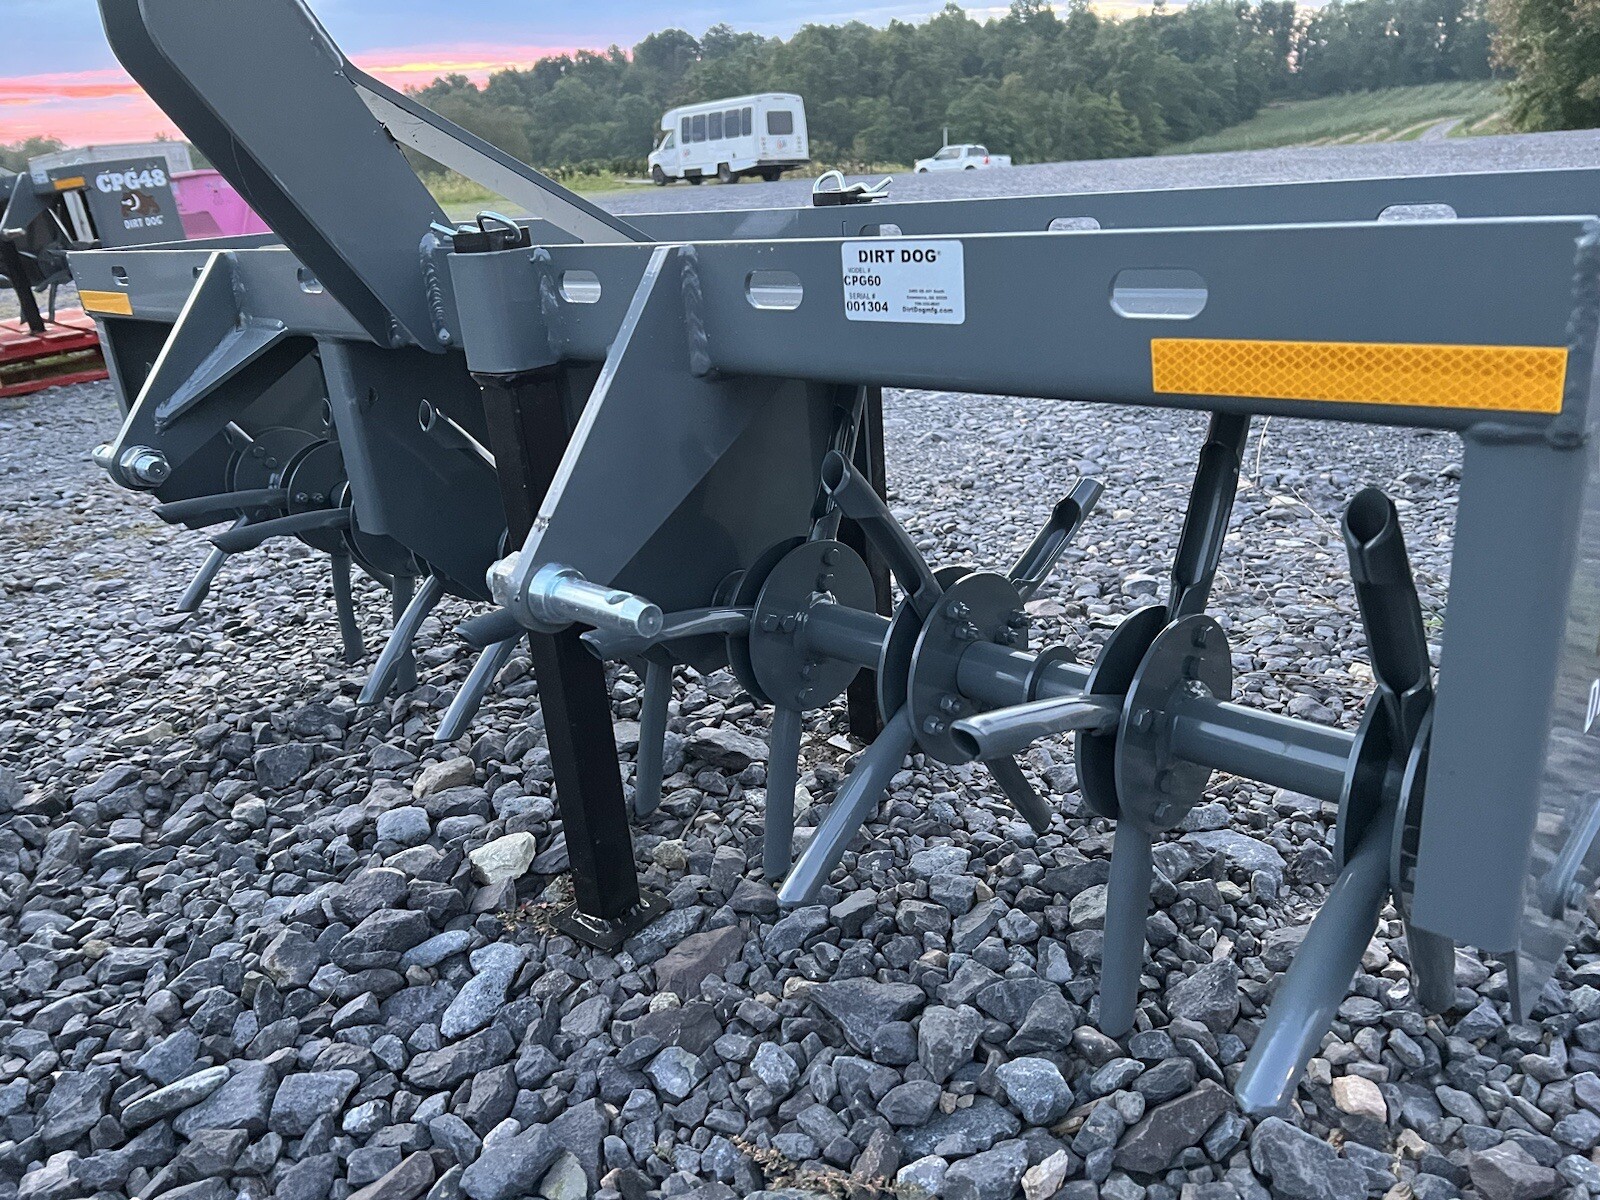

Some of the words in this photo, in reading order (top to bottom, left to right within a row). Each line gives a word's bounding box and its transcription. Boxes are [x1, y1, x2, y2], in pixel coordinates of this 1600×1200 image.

[96, 169, 167, 192] CPG48
[123, 218, 144, 230] DIRT
[859, 250, 895, 263] DIRT
[844, 275, 881, 286] CPG60
[849, 292, 870, 300] SERIAL
[847, 302, 888, 312] 001304
